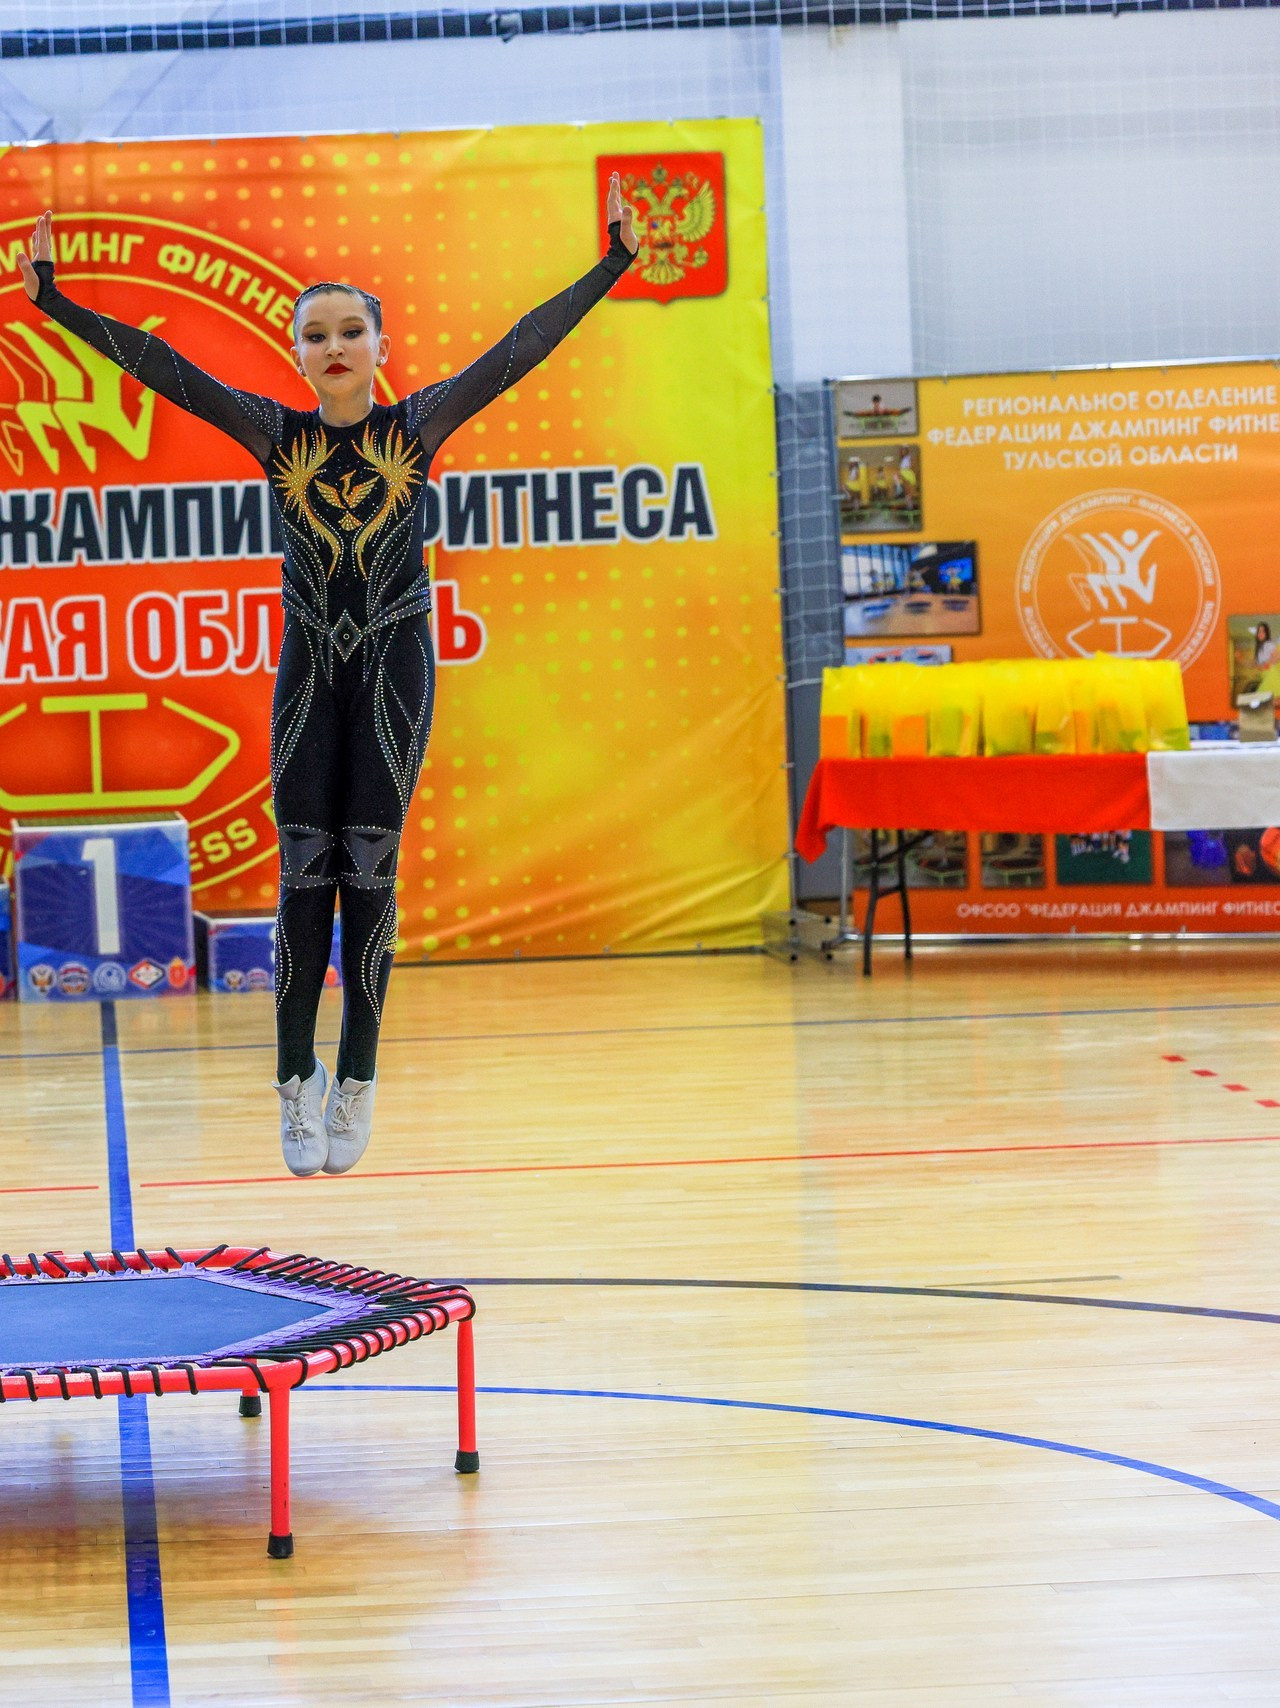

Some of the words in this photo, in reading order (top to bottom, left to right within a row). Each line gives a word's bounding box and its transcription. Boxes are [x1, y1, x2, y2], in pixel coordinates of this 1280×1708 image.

[157, 243, 297, 341] ФИТНЕ
[963, 390, 1139, 417] РЕГИОНАЛЬНОЕ
[1146, 385, 1277, 410] ОТДЕЛЕНИЕ
[927, 423, 1061, 447] ФЕДЕРАЦИИ
[1068, 416, 1201, 441] ДЖАМПИНГ
[1208, 412, 1280, 434] ФИТНЕ
[1003, 444, 1122, 471] ТУЛЬСКОЙ
[1129, 443, 1238, 466] ОБЛАСТИ
[126, 579, 488, 681] ОБЛЬ
[81, 837, 121, 954] 1
[1126, 901, 1219, 918] ДЖАМПИНГ
[1222, 900, 1280, 917] ФИТНЕС
